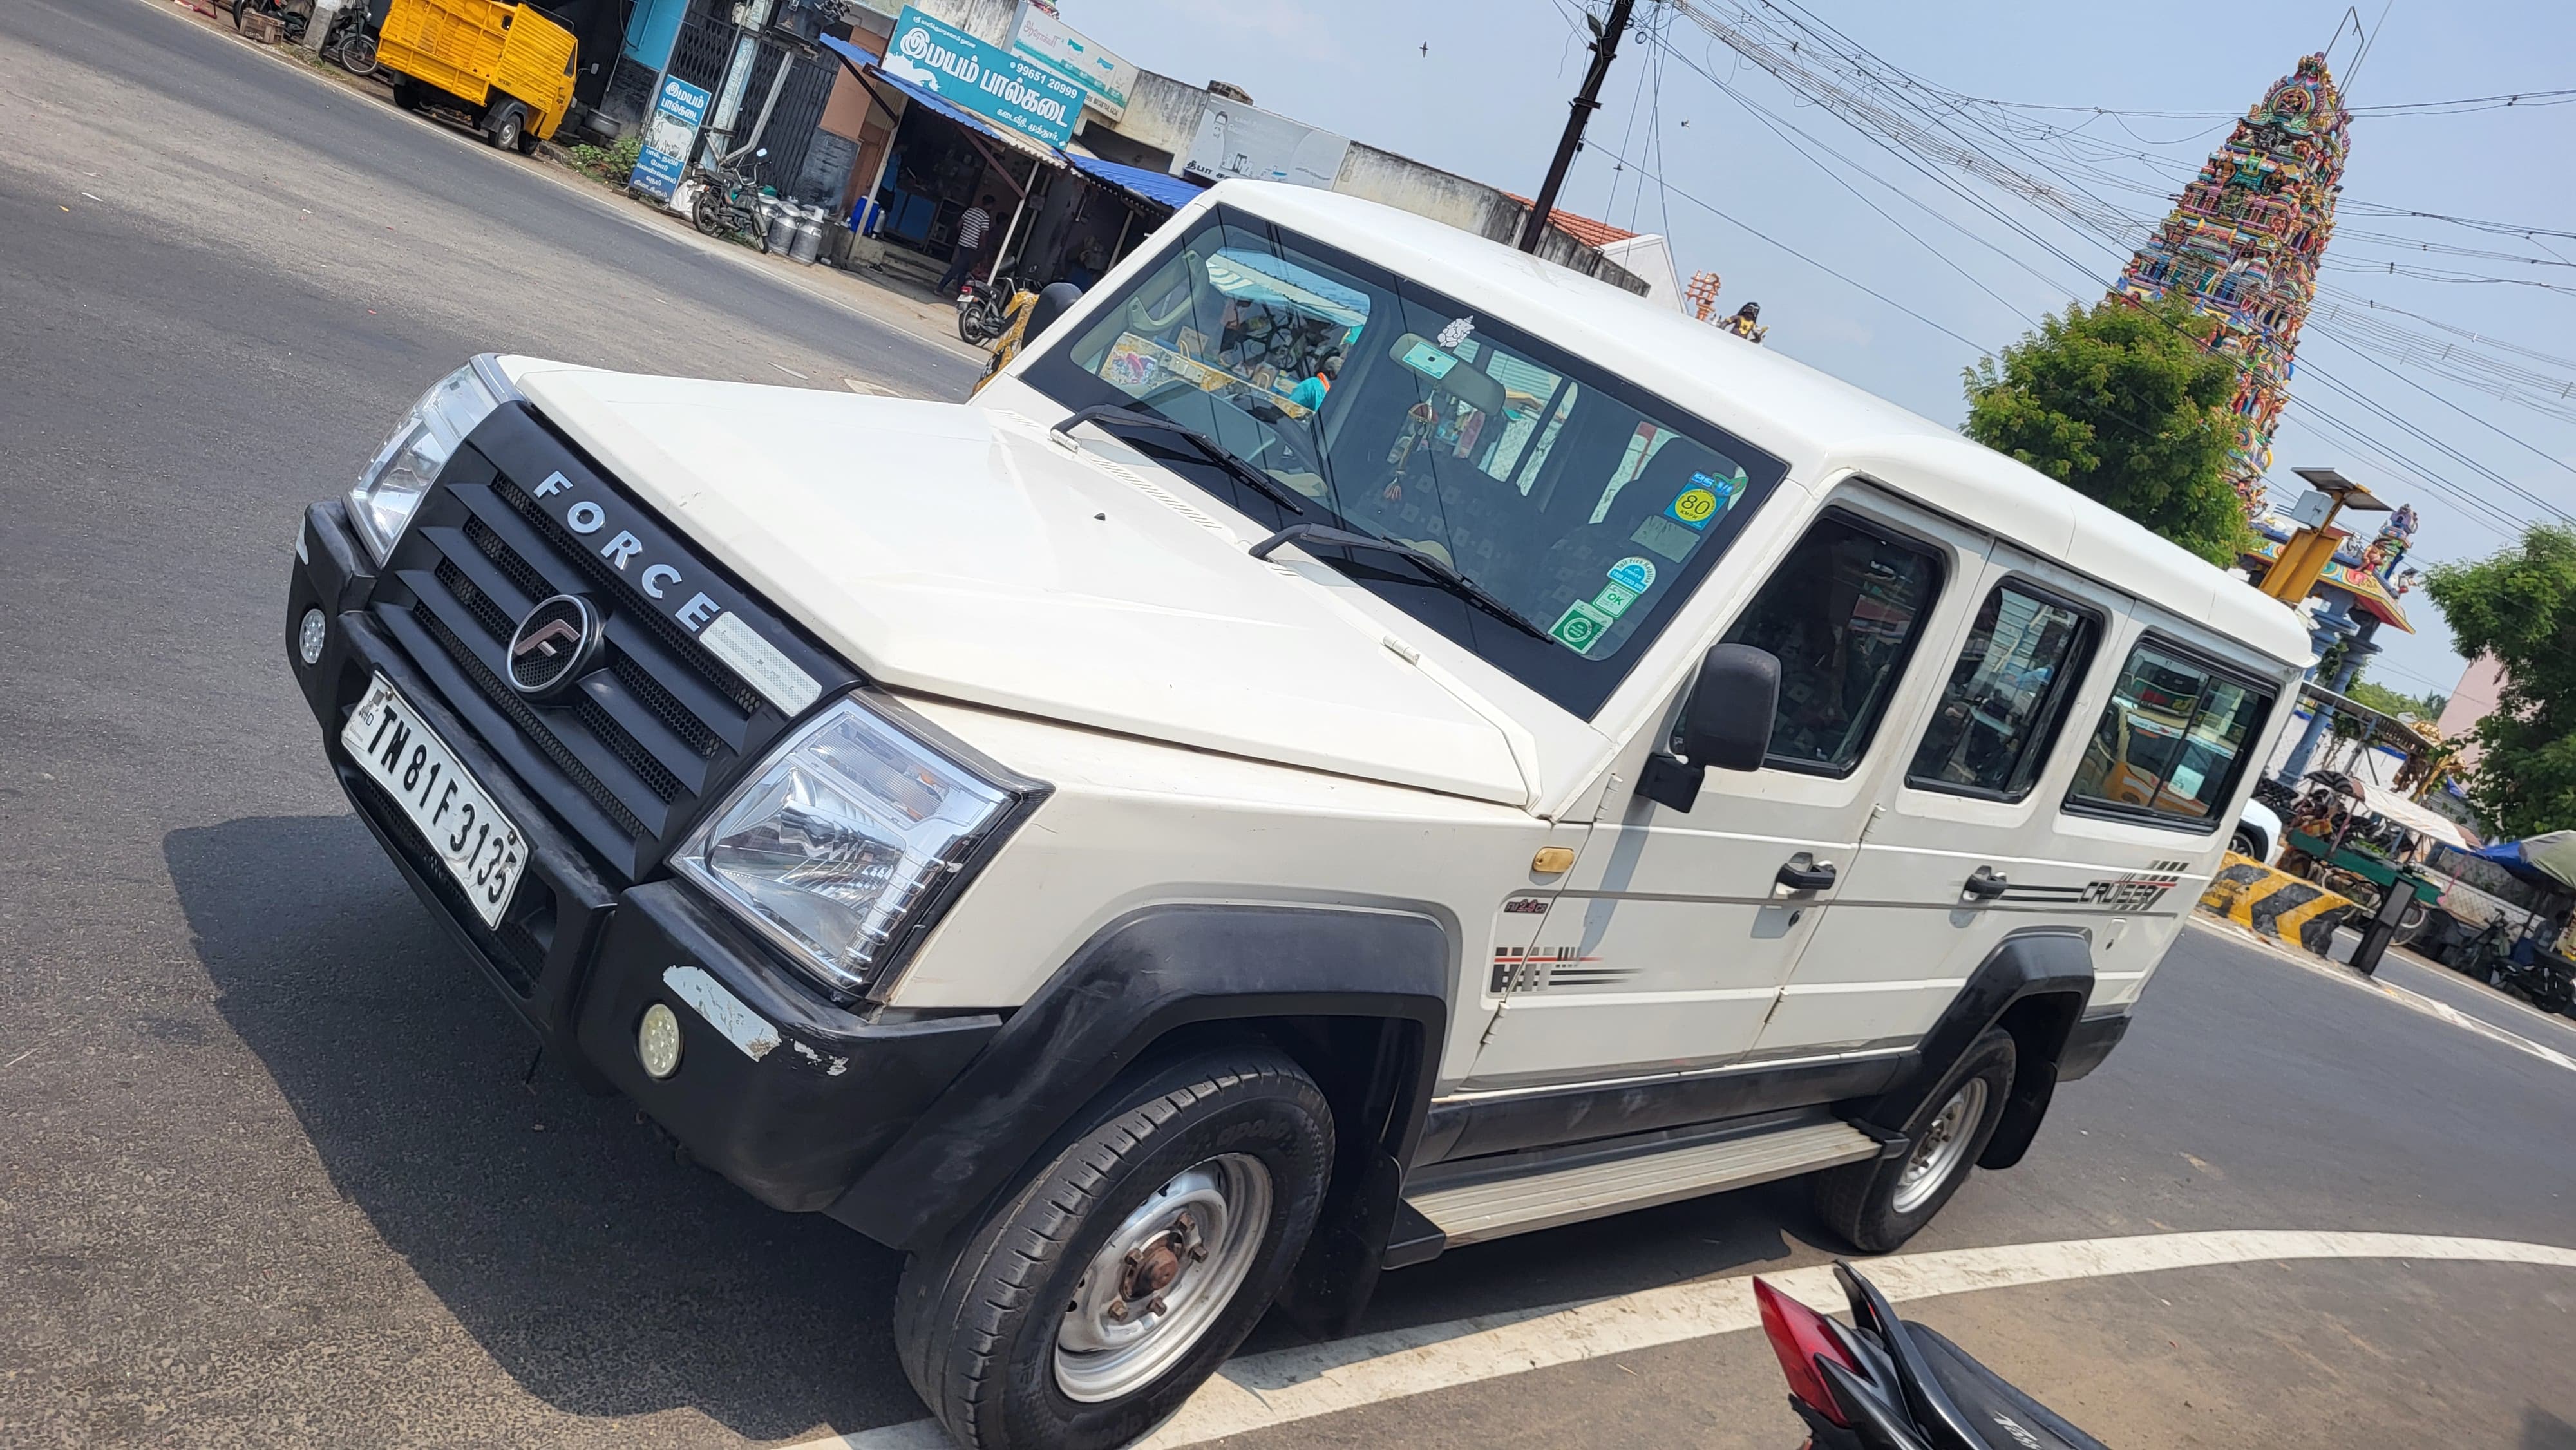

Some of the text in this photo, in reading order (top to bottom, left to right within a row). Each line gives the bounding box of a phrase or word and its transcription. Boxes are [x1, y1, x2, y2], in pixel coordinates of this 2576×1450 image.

[899, 26, 1068, 128] இமயம் பால்கடை
[1016, 62, 1046, 85] 99651
[1046, 79, 1078, 99] 20999
[665, 82, 704, 109] இமயம்
[661, 98, 698, 122] பால்கடை
[1186, 160, 1213, 175] தீபா
[1681, 495, 1710, 514] 80
[533, 471, 721, 632] FORCE
[1607, 593, 1625, 605] OK
[2079, 881, 2158, 904] CRUISER
